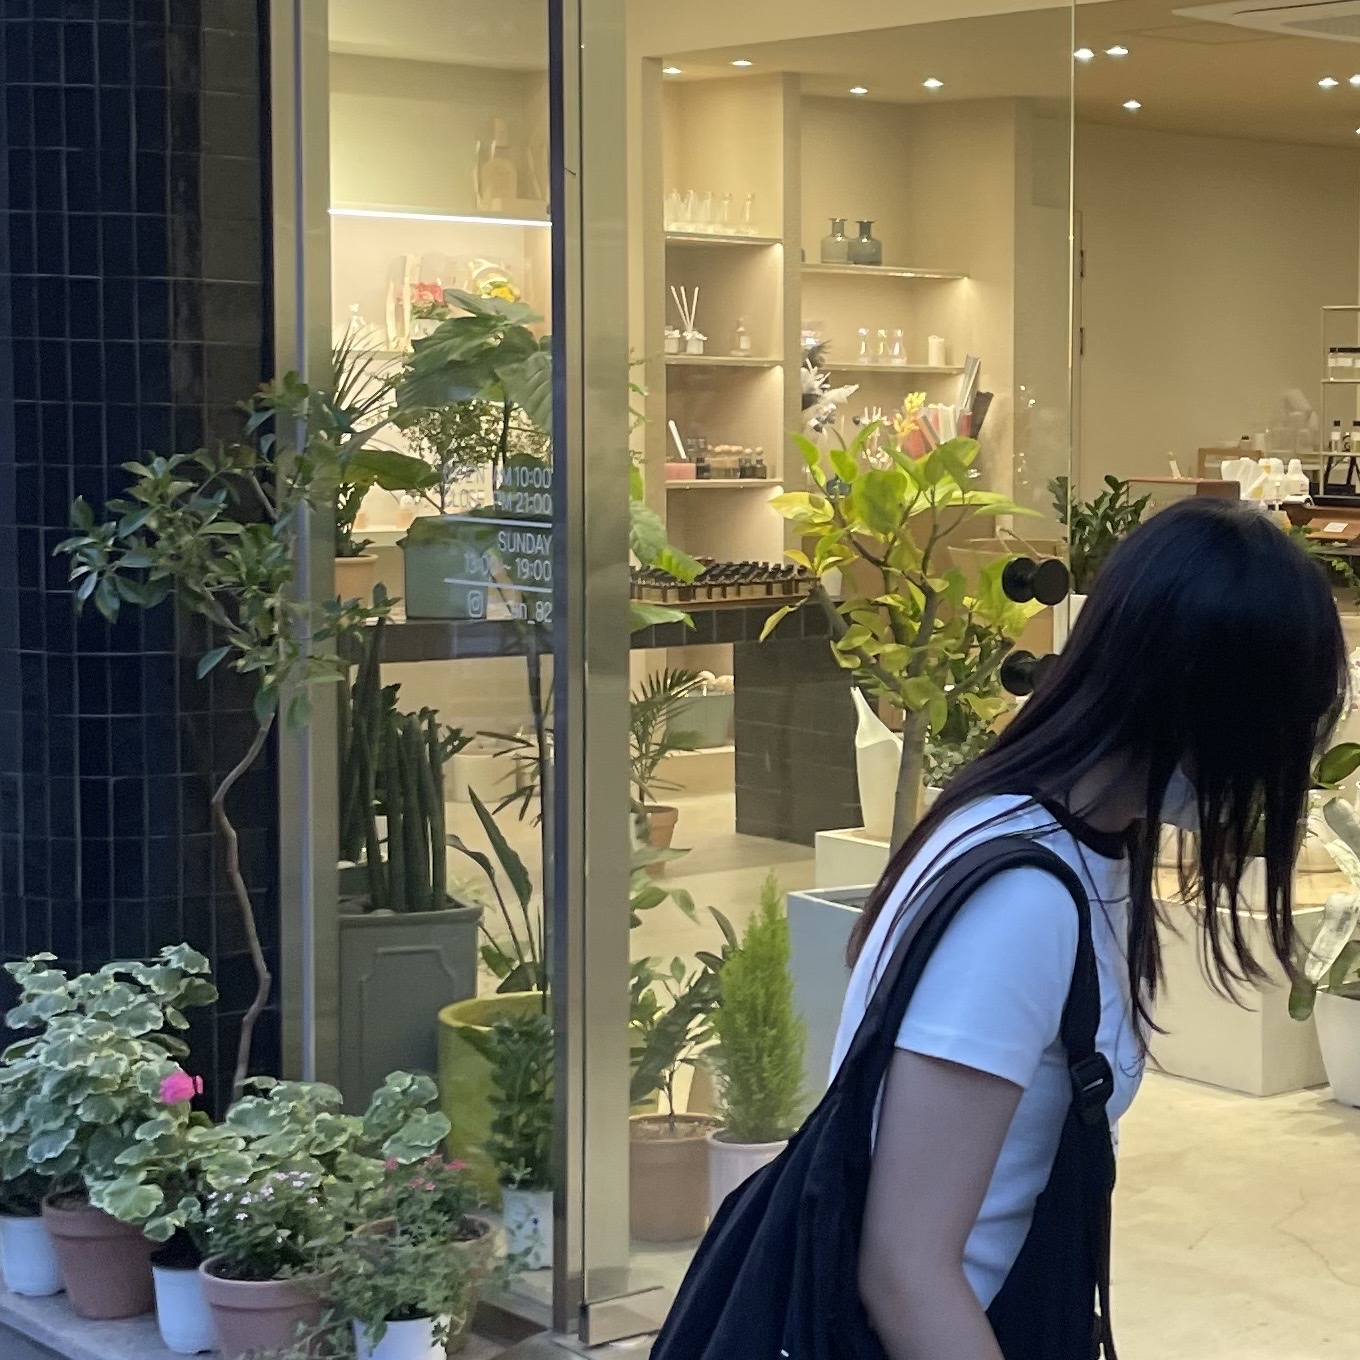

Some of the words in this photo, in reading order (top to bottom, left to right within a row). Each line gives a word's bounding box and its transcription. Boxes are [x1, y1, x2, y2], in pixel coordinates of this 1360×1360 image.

[514, 465, 552, 490] 10:00
[515, 490, 552, 515] 21:00
[497, 529, 553, 556] SUNDAY
[515, 556, 552, 581] 19:00
